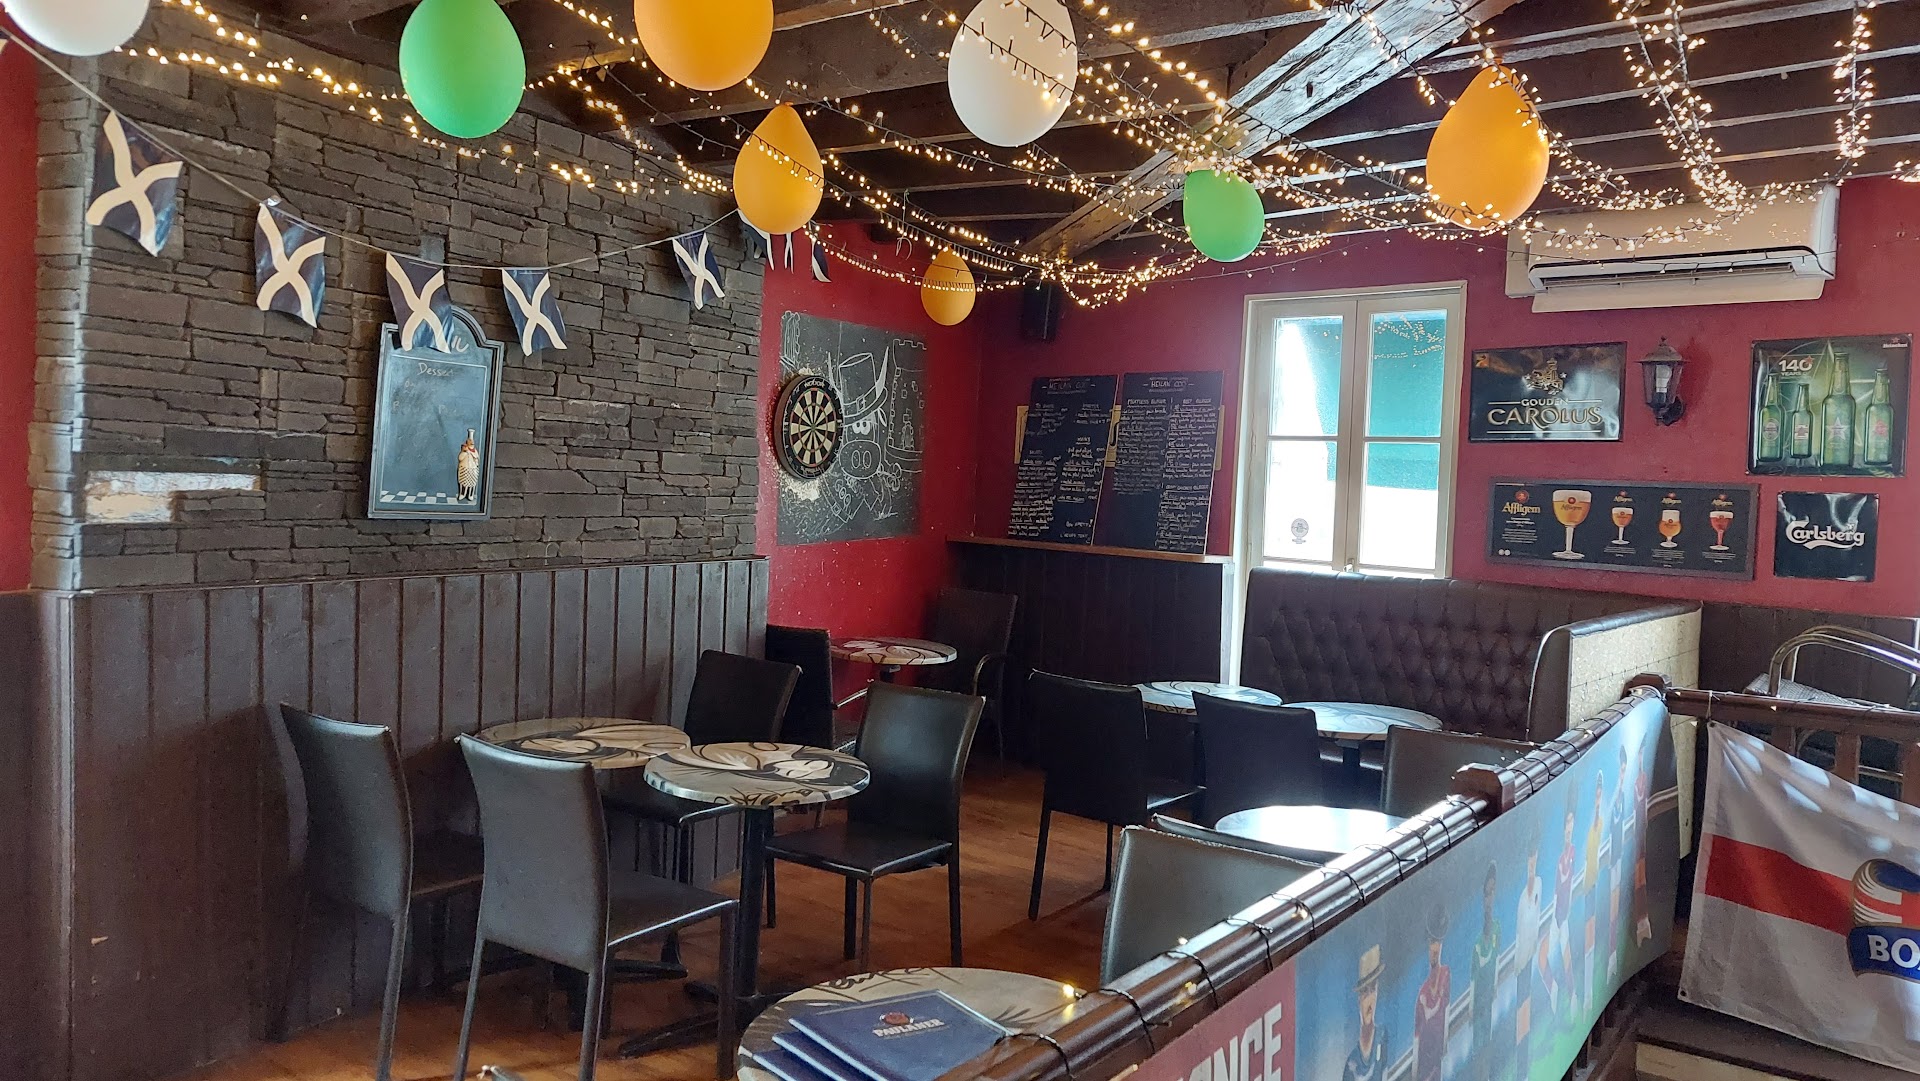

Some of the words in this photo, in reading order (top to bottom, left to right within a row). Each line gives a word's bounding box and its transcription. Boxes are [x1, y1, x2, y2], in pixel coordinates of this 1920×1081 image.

[1778, 358, 1814, 372] 140
[1520, 398, 1569, 407] GOUDEN
[1487, 406, 1602, 430] CAROLUS
[1502, 501, 1541, 516] Affligem
[1785, 516, 1865, 549] Carlsberg
[1867, 934, 1920, 971] BO
[872, 1018, 945, 1037] PAULANER
[1178, 1003, 1282, 1081] NCE
